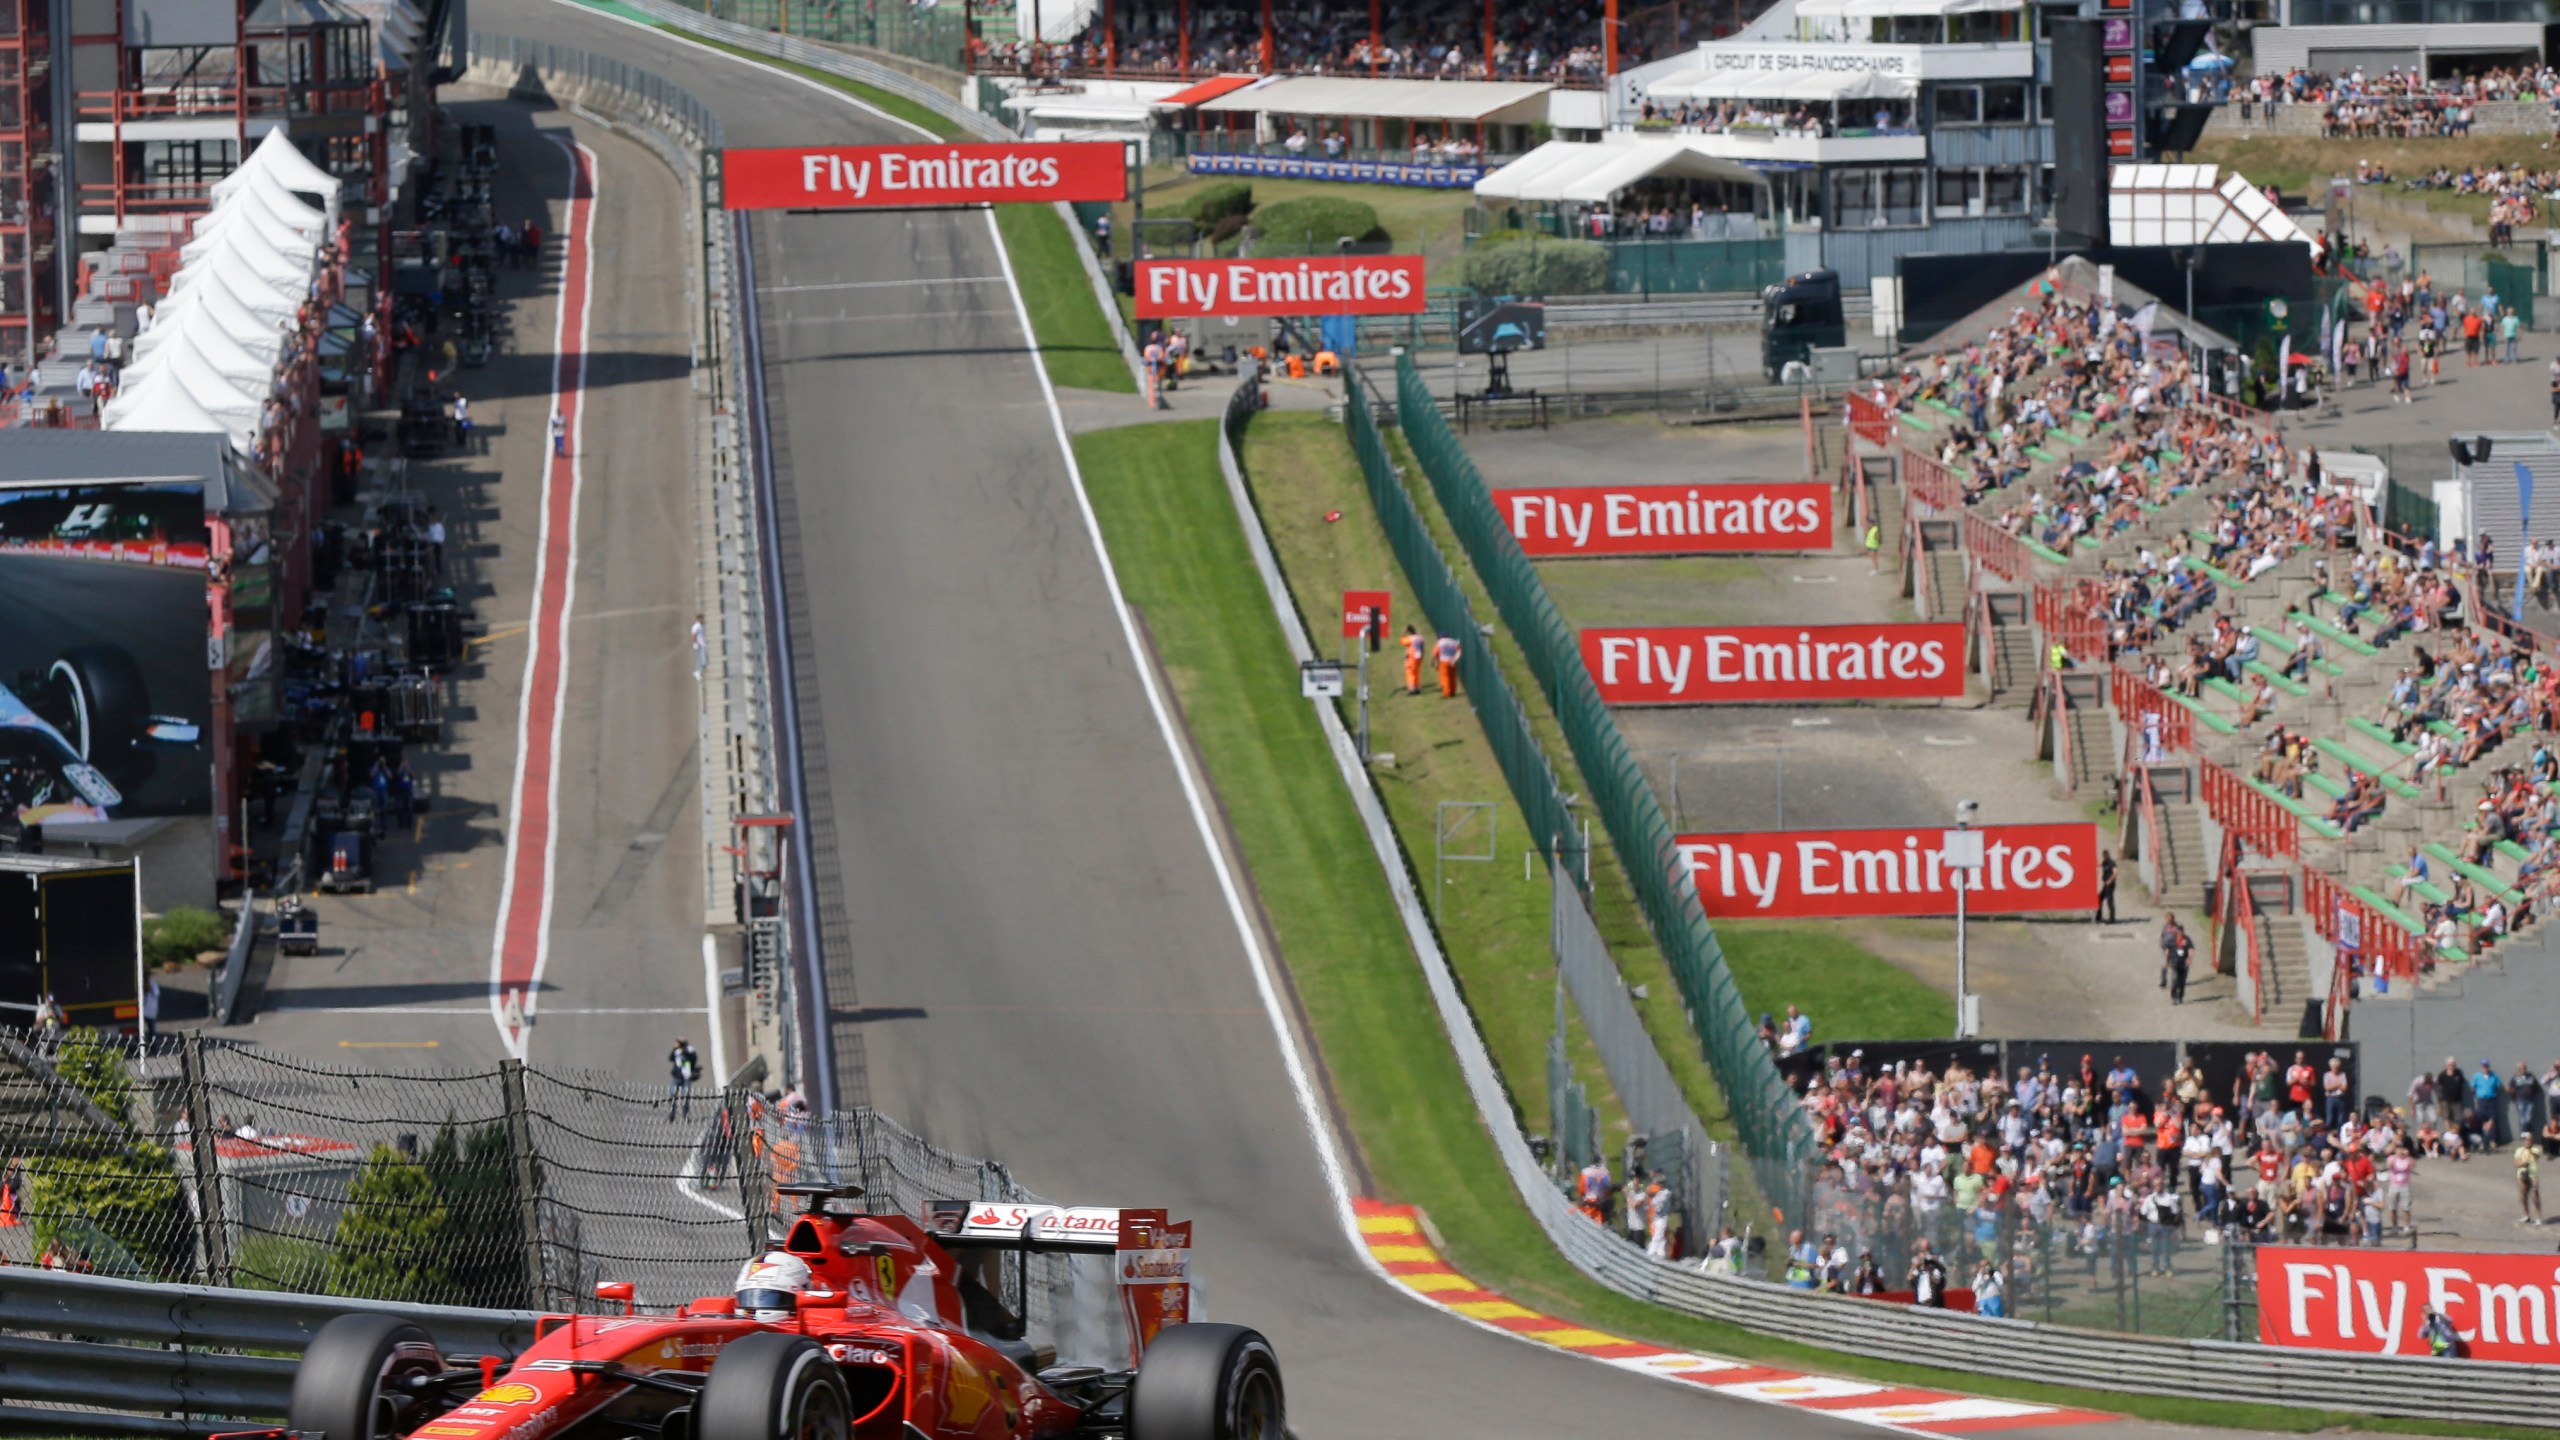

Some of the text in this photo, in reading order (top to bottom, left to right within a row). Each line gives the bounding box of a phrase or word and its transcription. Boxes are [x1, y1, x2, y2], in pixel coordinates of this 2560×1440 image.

[1714, 54, 1904, 72] CIRCUIT DE SPA-FRANCORCHAMPS
[802, 150, 1060, 199] Fly Emirates
[1148, 263, 1411, 311] Fly Emirates
[1511, 489, 1820, 547] Fly Emirates
[1600, 632, 1945, 694] Fly Emirates
[1676, 842, 1781, 909] Fly
[1005, 1208, 1119, 1231] Sntan
[2284, 1262, 2406, 1355] Fly
[519, 1359, 573, 1371] 5
[828, 1344, 888, 1364] Claro
